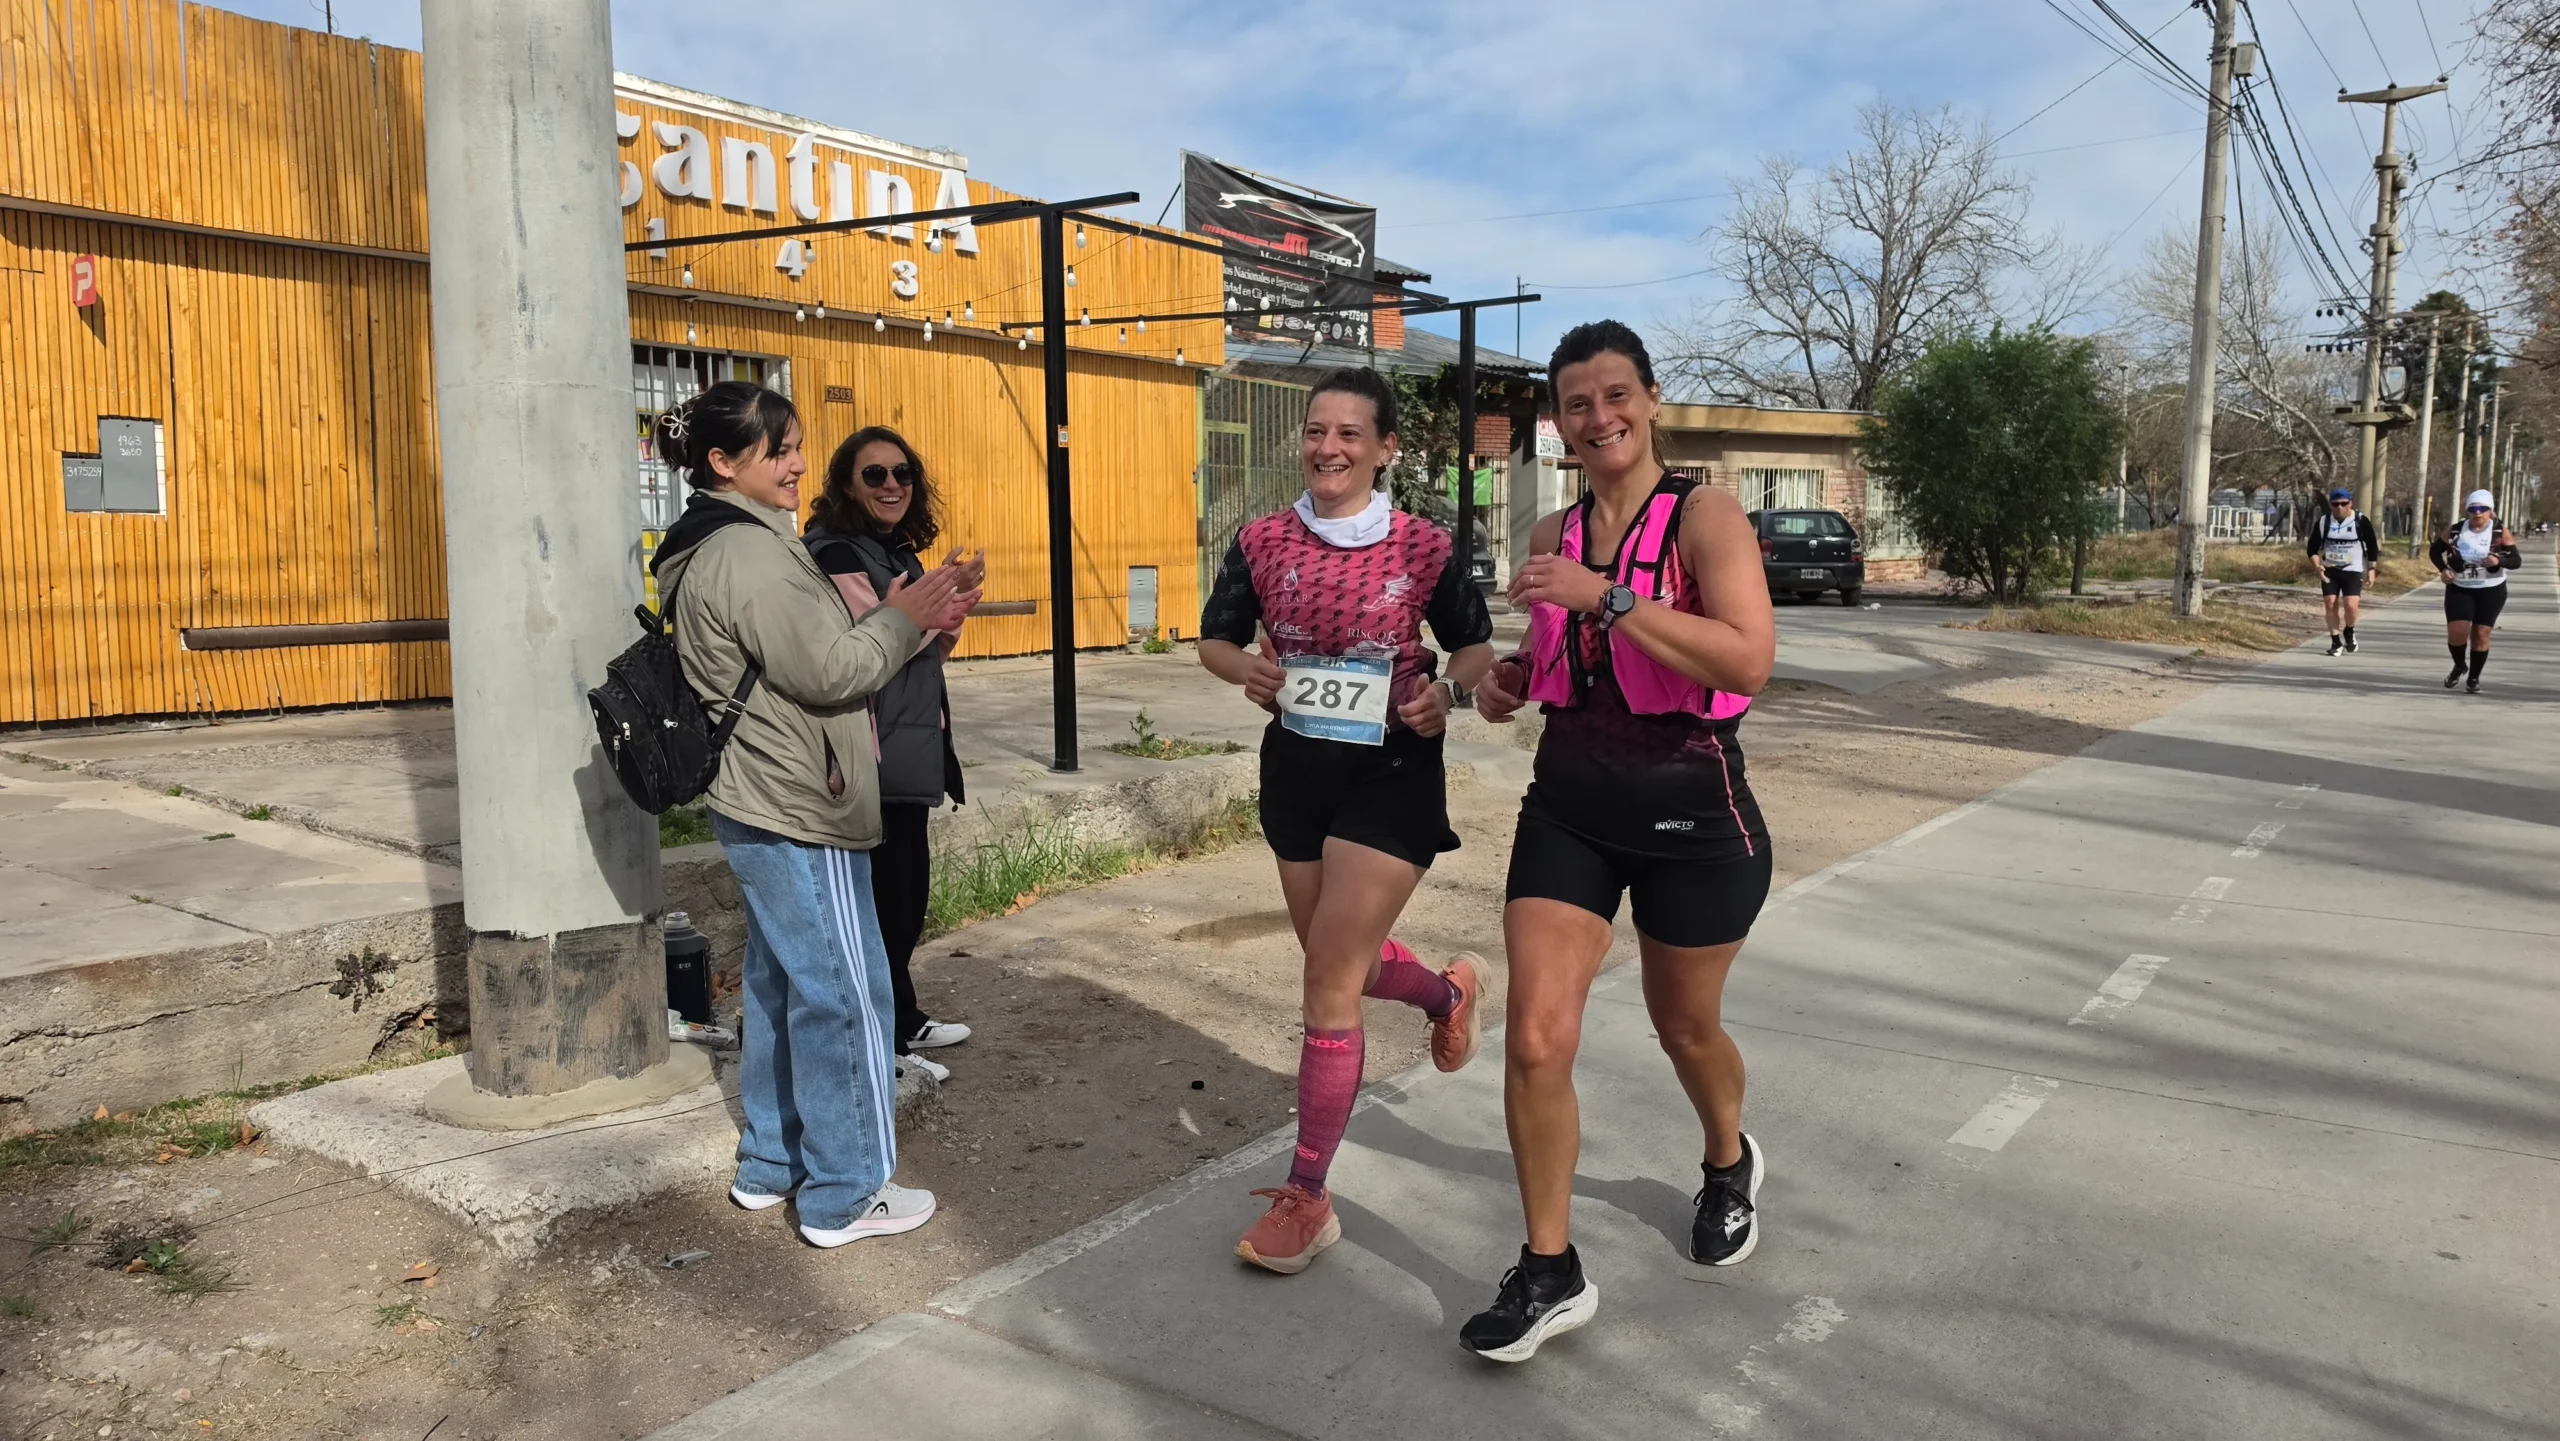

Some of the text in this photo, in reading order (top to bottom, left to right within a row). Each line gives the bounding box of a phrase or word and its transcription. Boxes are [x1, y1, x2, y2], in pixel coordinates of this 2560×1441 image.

[891, 260, 919, 297] 3
[1234, 266, 1270, 284] Nacionales
[828, 386, 851, 400] 2503
[118, 436, 142, 446] 1963
[120, 448, 142, 456] 3650
[1294, 677, 1369, 711] 287
[1655, 819, 1695, 830] INVICTO
